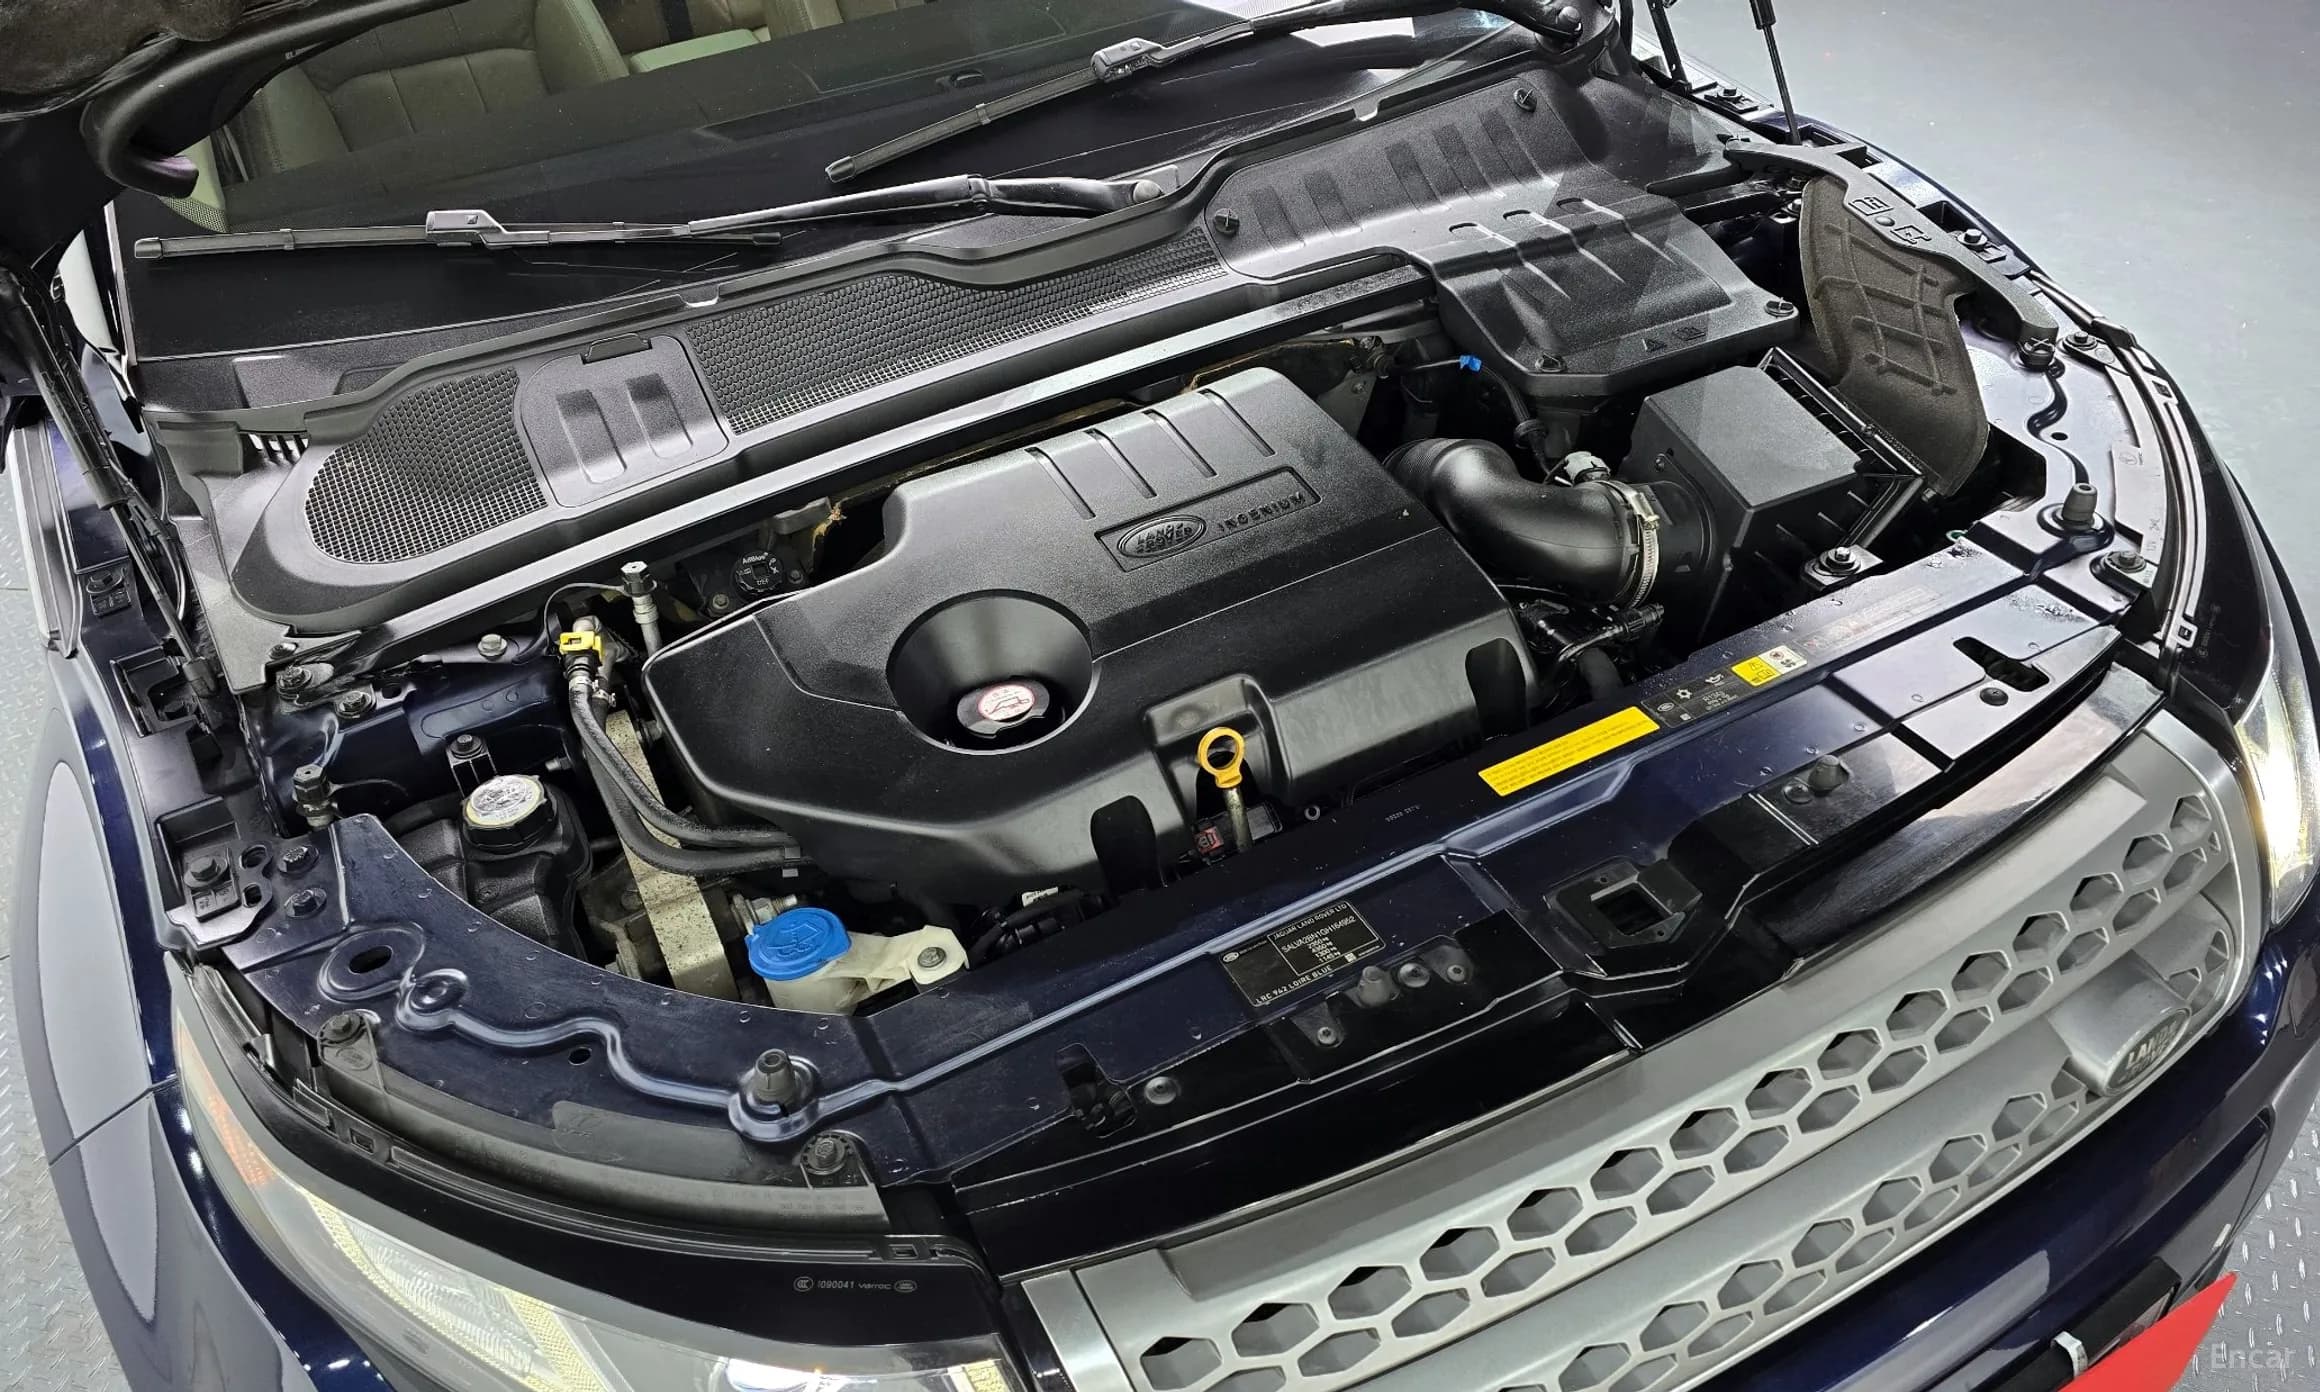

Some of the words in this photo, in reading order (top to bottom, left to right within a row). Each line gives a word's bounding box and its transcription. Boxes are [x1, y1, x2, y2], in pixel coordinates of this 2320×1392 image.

[1217, 491, 1306, 532] INGENIUM
[1144, 526, 1194, 550] ROVER
[1273, 925, 1297, 941] JAGUAR
[1297, 918, 1315, 930] LAND
[1314, 909, 1335, 921] ROVER
[1255, 992, 1273, 1004] LRC
[1288, 974, 1312, 989] LOIRE
[1311, 964, 1333, 978] BLUE
